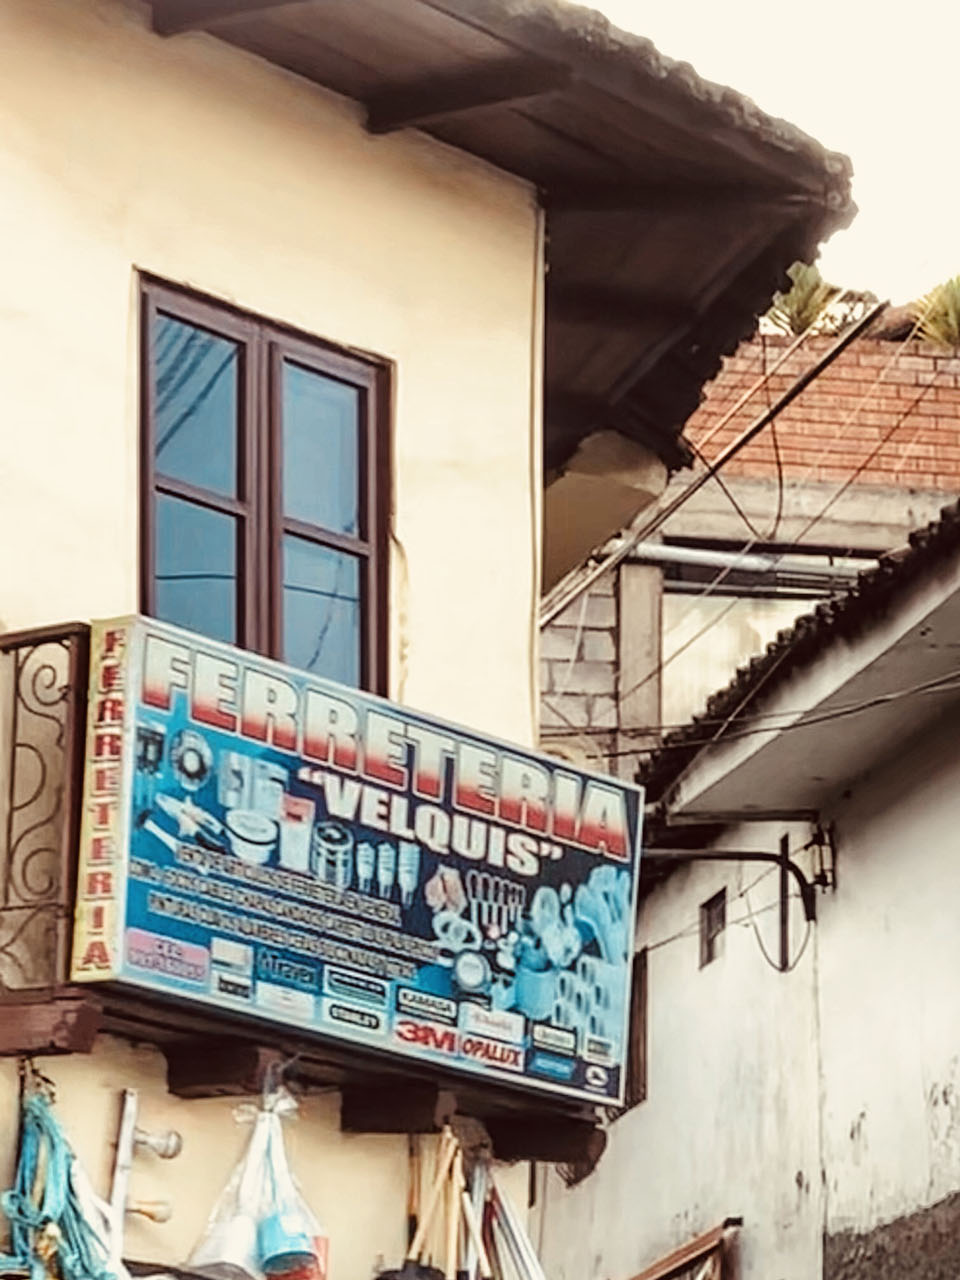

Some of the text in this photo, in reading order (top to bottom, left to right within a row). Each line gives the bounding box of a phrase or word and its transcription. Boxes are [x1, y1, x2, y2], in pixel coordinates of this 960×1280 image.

[82, 630, 125, 971] FERRETERIA
[141, 634, 629, 862] FERRETERIA
[395, 1019, 457, 1054] 3M
[461, 1037, 524, 1068] OPALUX
